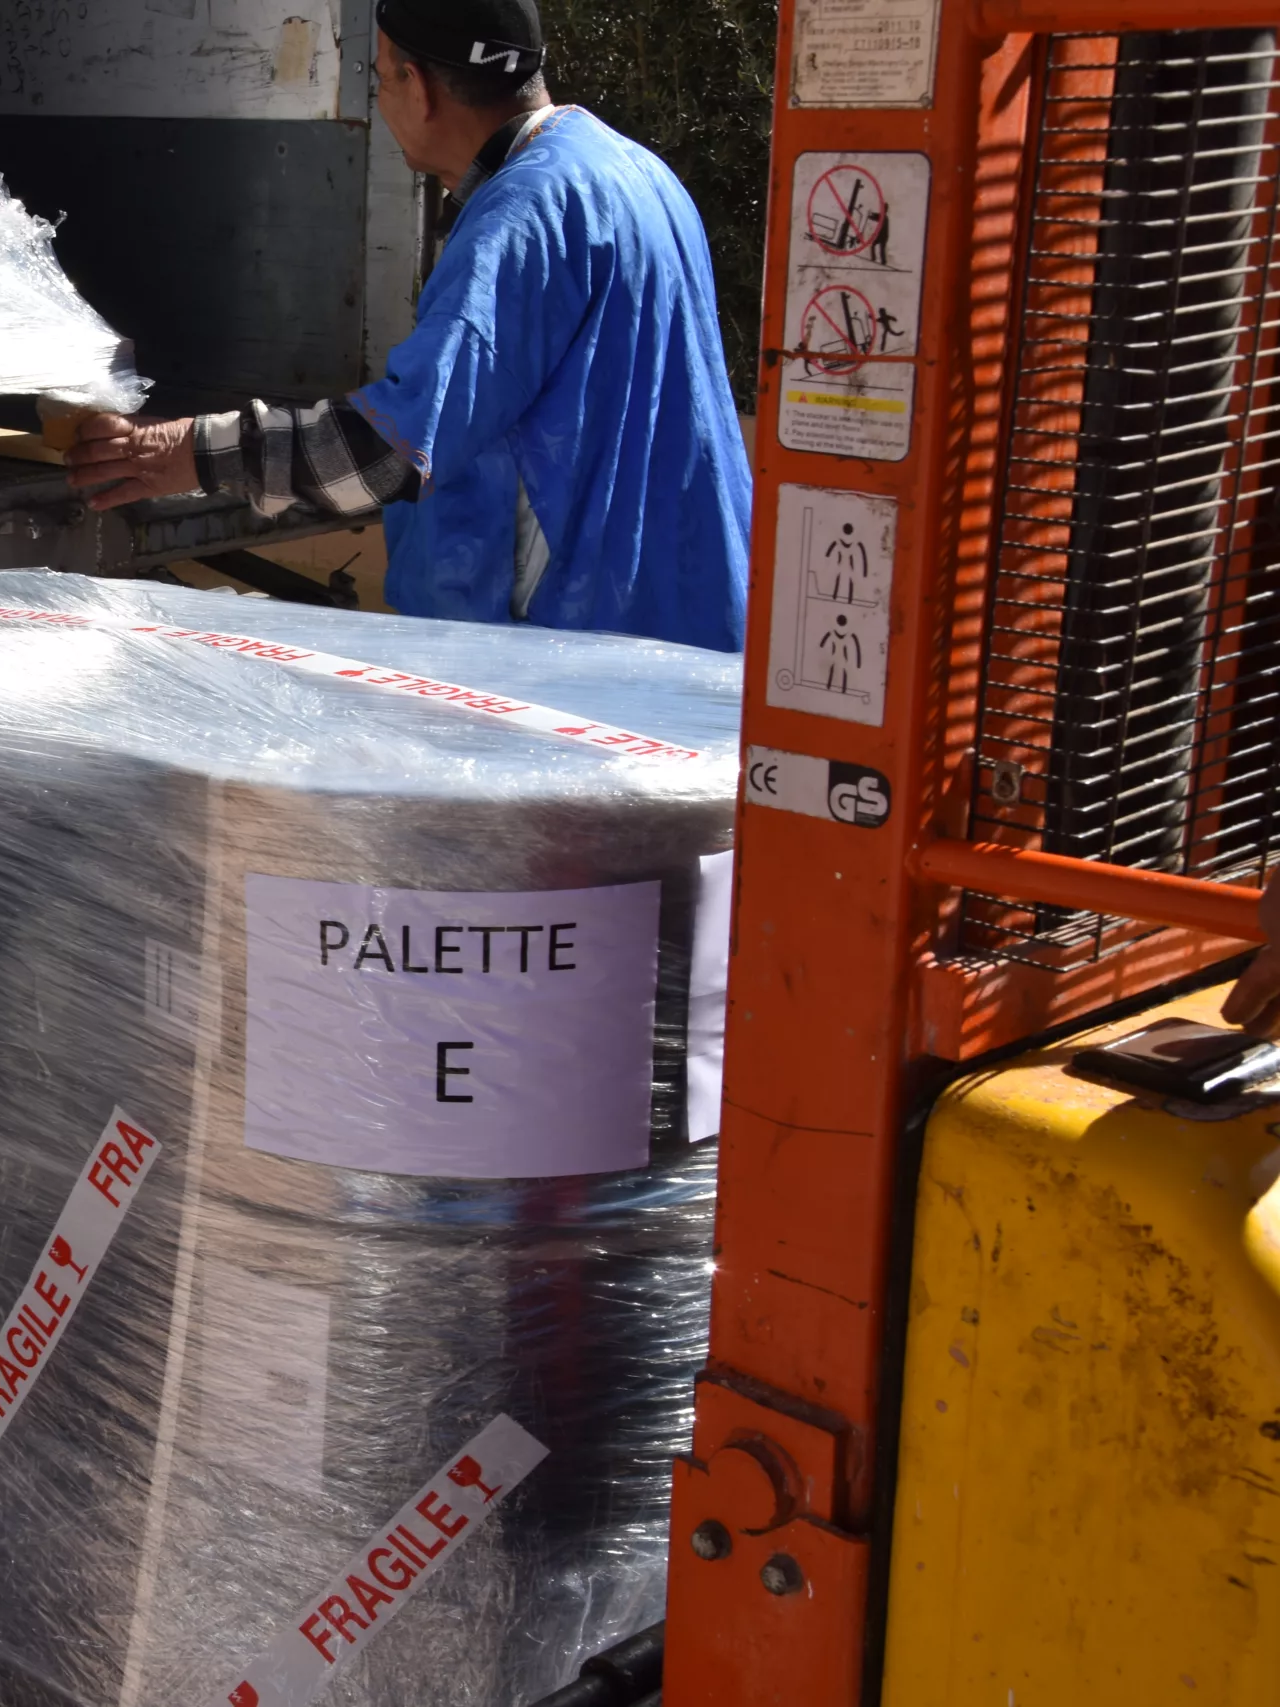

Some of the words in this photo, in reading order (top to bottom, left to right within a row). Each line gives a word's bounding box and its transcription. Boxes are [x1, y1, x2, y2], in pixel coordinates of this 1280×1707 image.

[162, 630, 316, 662] FRAGILE
[368, 673, 533, 715] FRAGILE
[749, 762, 779, 795] CE
[829, 776, 889, 823] GS
[320, 920, 578, 975] PALETTE
[436, 1041, 474, 1103] E
[86, 1118, 155, 1208] FRA
[297, 1489, 472, 1666] FRAGILE
